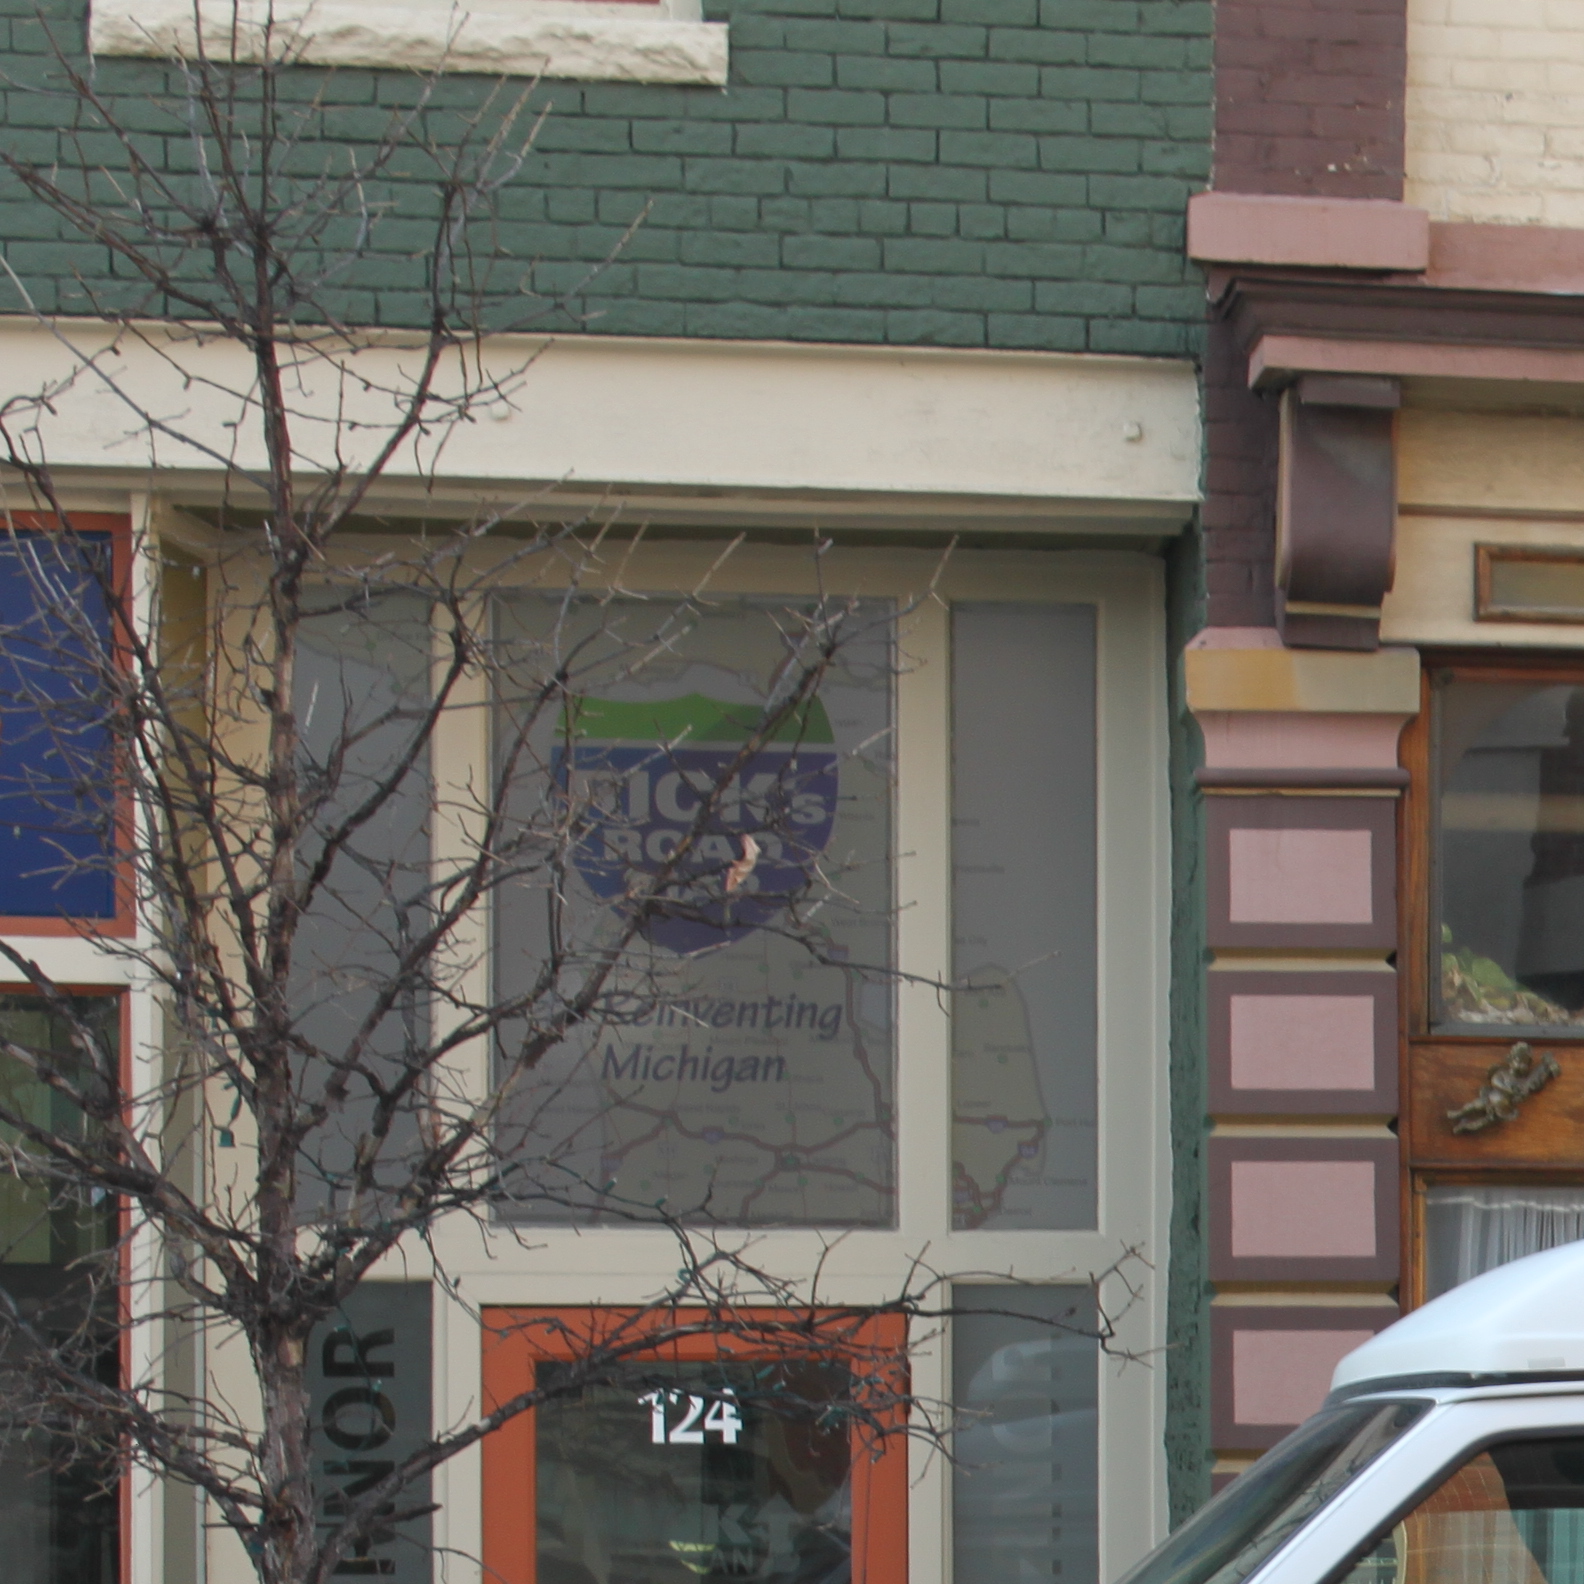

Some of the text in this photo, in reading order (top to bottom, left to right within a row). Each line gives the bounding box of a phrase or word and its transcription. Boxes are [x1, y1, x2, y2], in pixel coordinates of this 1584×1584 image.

[601, 993, 844, 1041] Reinventing
[600, 1042, 787, 1093] Michigan
[637, 1387, 743, 1445] 124
